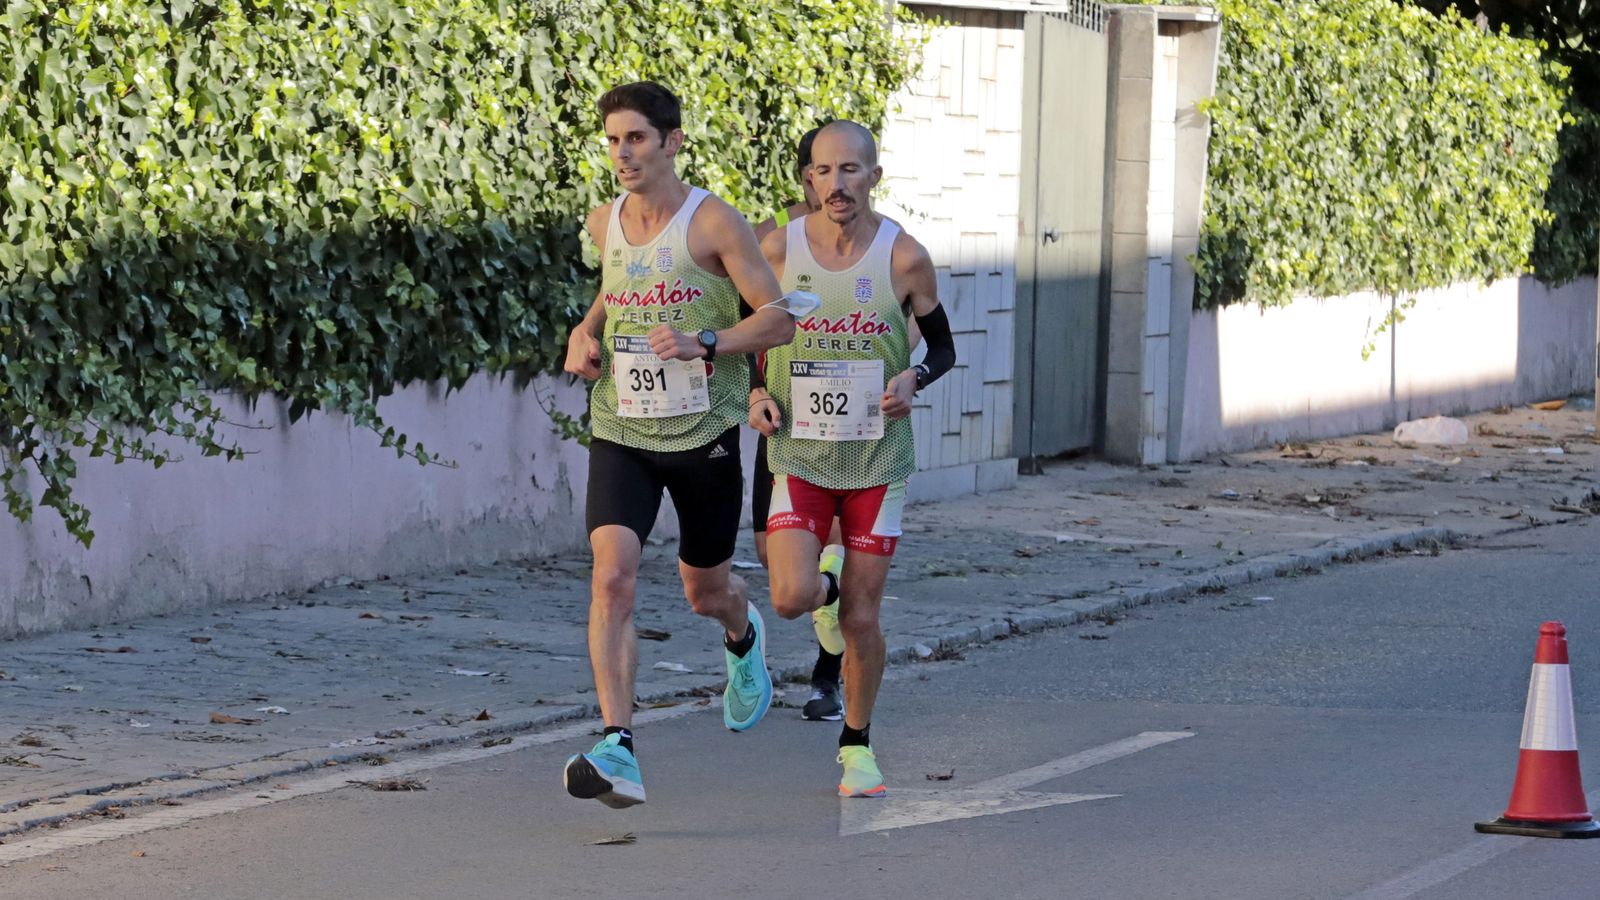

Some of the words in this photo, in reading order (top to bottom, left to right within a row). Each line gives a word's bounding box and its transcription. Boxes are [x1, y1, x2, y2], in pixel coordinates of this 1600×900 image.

[605, 279, 702, 306] maratón
[620, 309, 683, 323] JEREZ
[795, 311, 892, 336] aratón
[615, 337, 628, 350] XXV
[804, 338, 872, 351] JEREZ
[634, 355, 659, 363] ANTO
[792, 362, 808, 374] XXV
[629, 367, 667, 392] 391
[819, 379, 851, 387] EMILIO
[809, 391, 849, 416] 362
